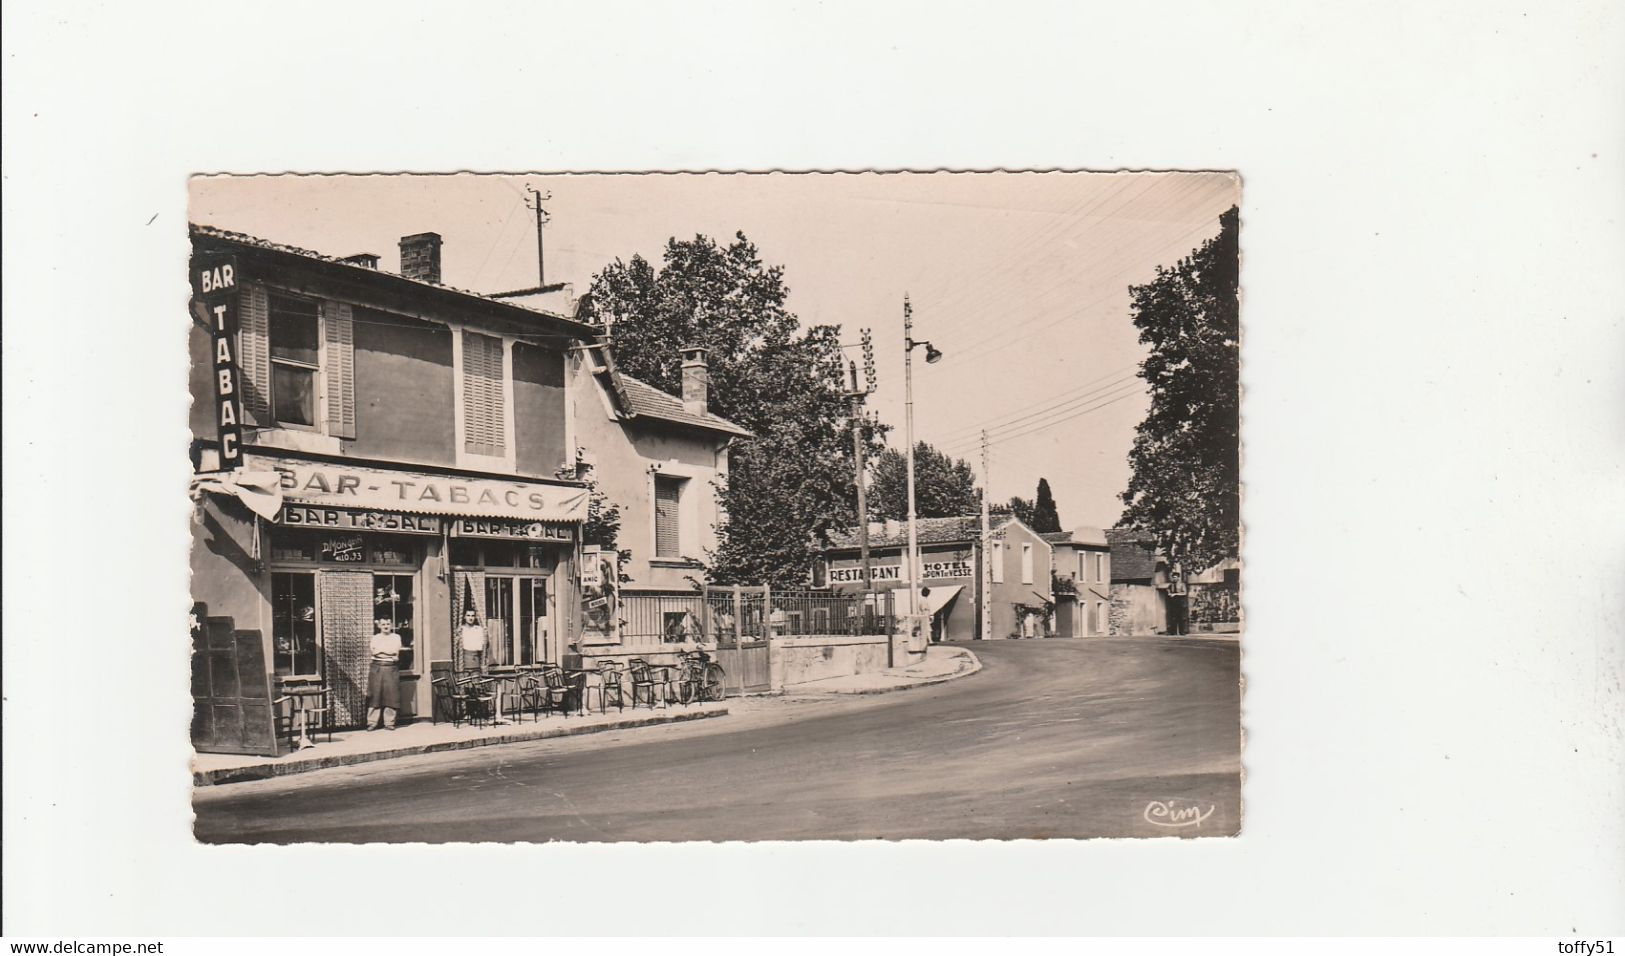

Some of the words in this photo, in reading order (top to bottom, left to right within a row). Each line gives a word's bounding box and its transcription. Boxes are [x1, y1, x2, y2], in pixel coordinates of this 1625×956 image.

[202, 264, 235, 293] BAR
[214, 304, 239, 460] TABAC
[284, 508, 339, 525] BAR
[462, 520, 501, 536] BAR
[830, 566, 900, 582] RESTARANT
[923, 561, 970, 571] HOTEL
